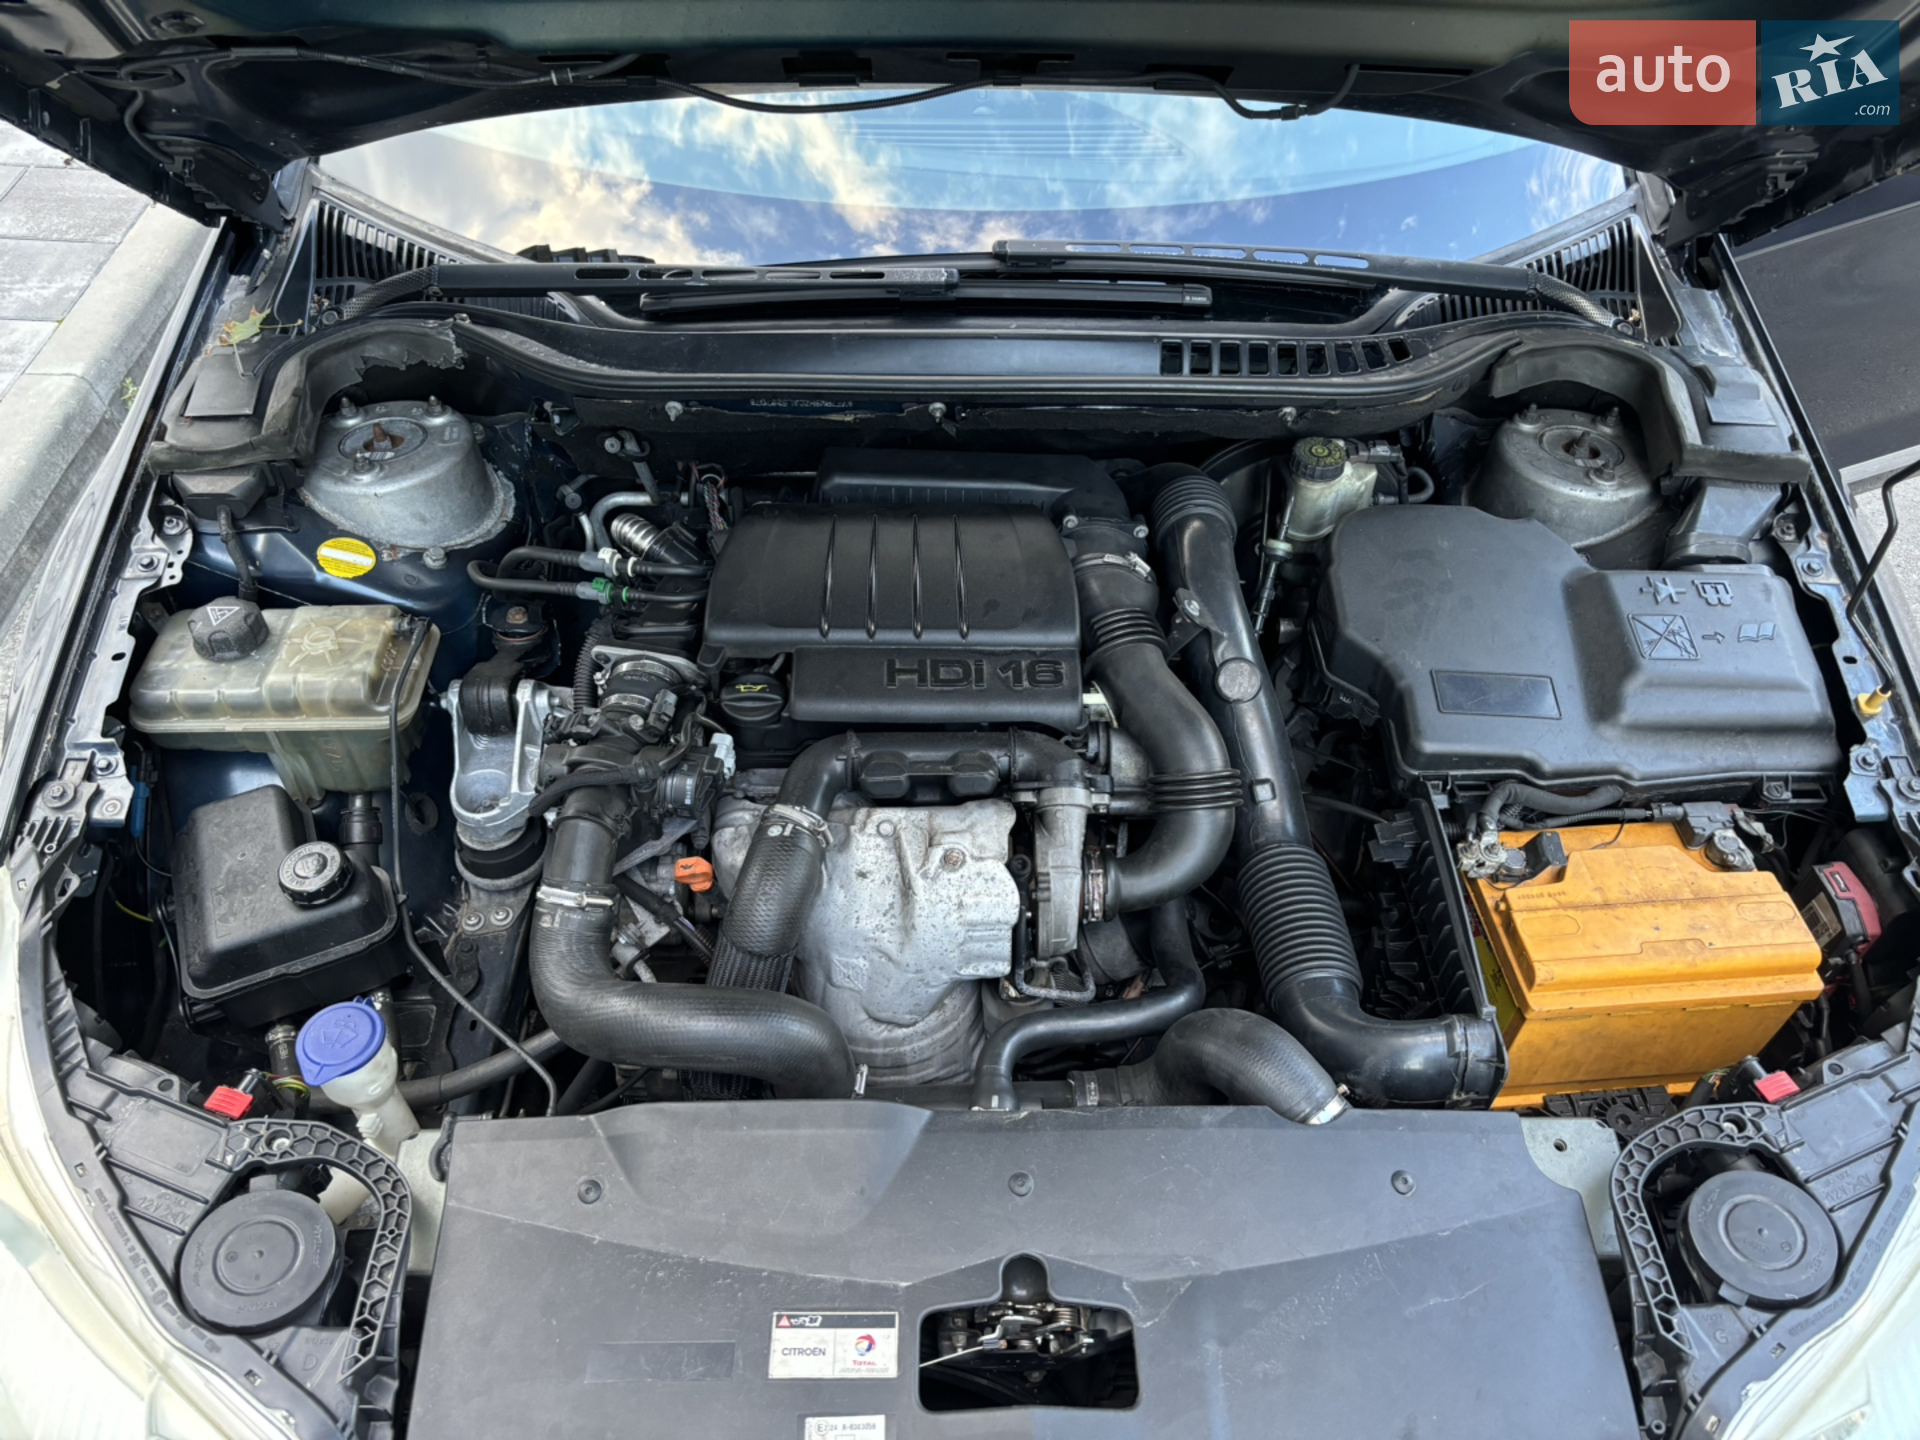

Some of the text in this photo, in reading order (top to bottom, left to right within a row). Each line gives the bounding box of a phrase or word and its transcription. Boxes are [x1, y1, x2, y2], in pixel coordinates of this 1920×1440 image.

[886, 659, 1065, 688] HDi 16
[782, 1347, 826, 1356] CITROËN
